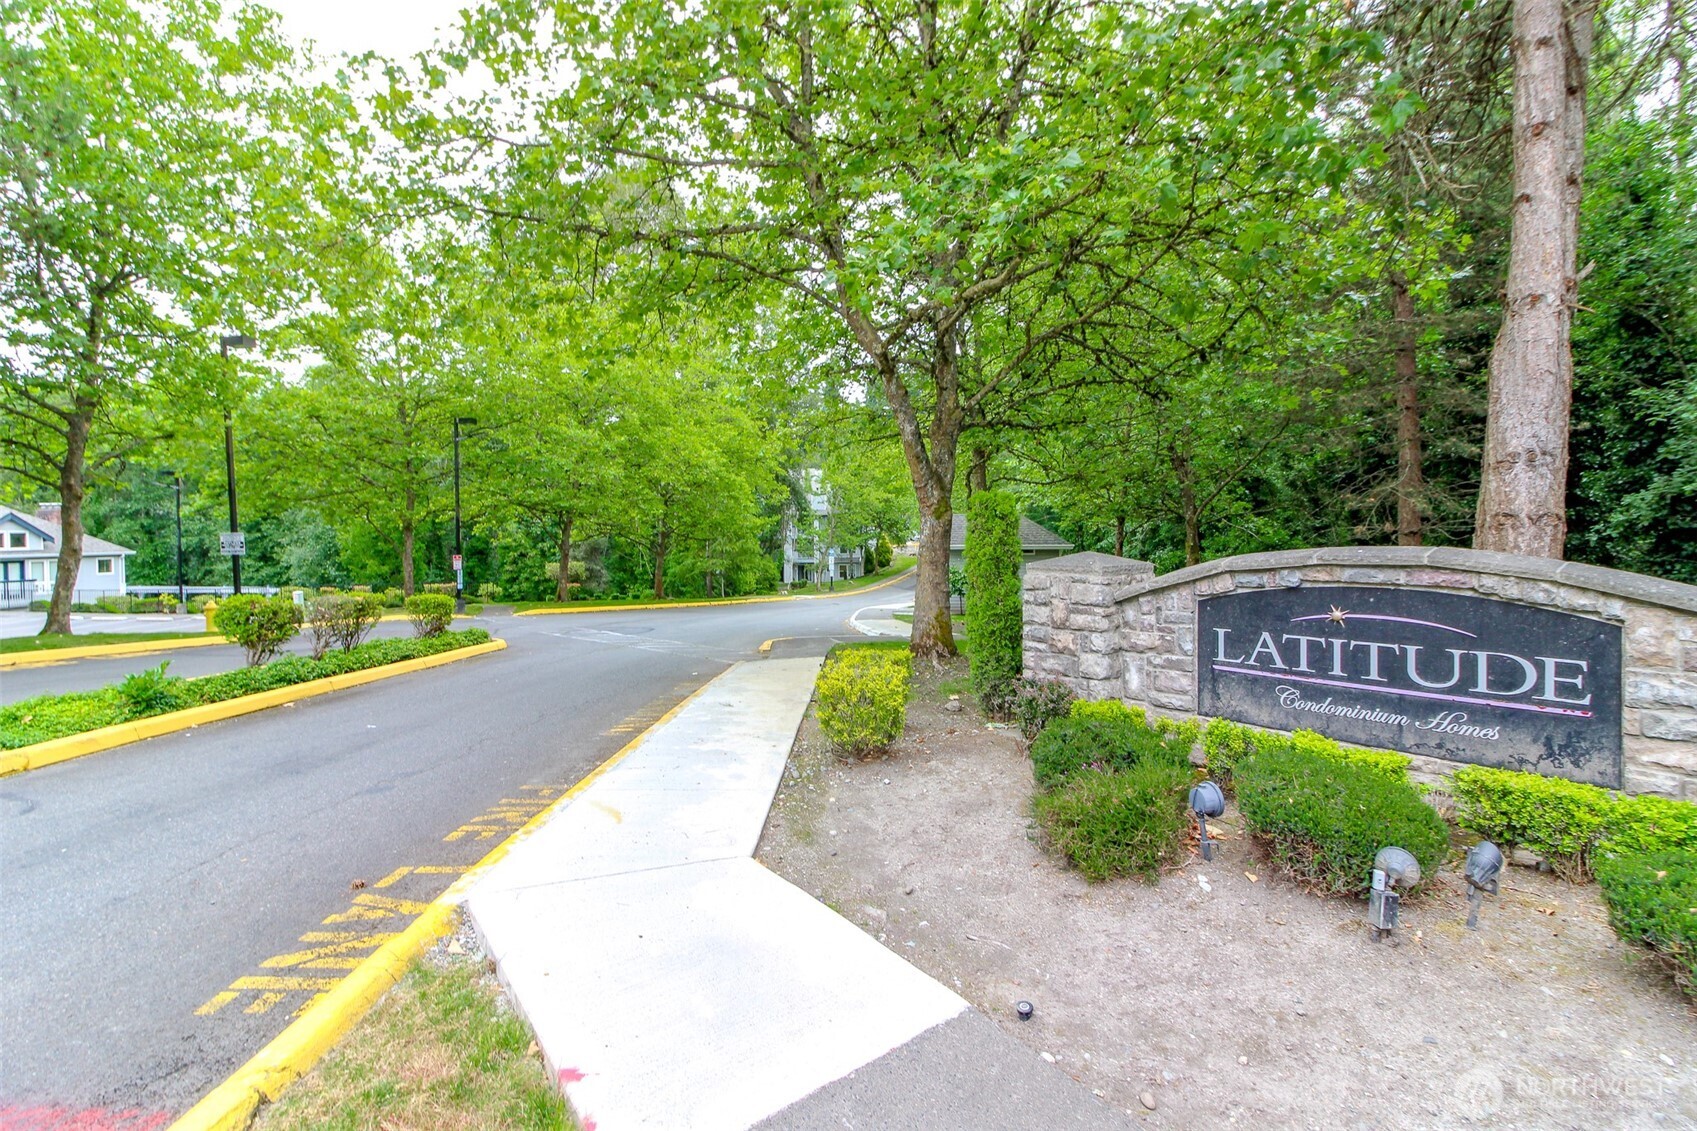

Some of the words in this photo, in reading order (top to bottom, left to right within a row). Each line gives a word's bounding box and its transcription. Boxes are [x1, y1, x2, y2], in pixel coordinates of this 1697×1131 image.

[1212, 628, 1592, 706] LATITUDE
[1275, 685, 1410, 727] Condominium
[1415, 711, 1501, 741] Homes
[193, 865, 475, 1017] LANE
